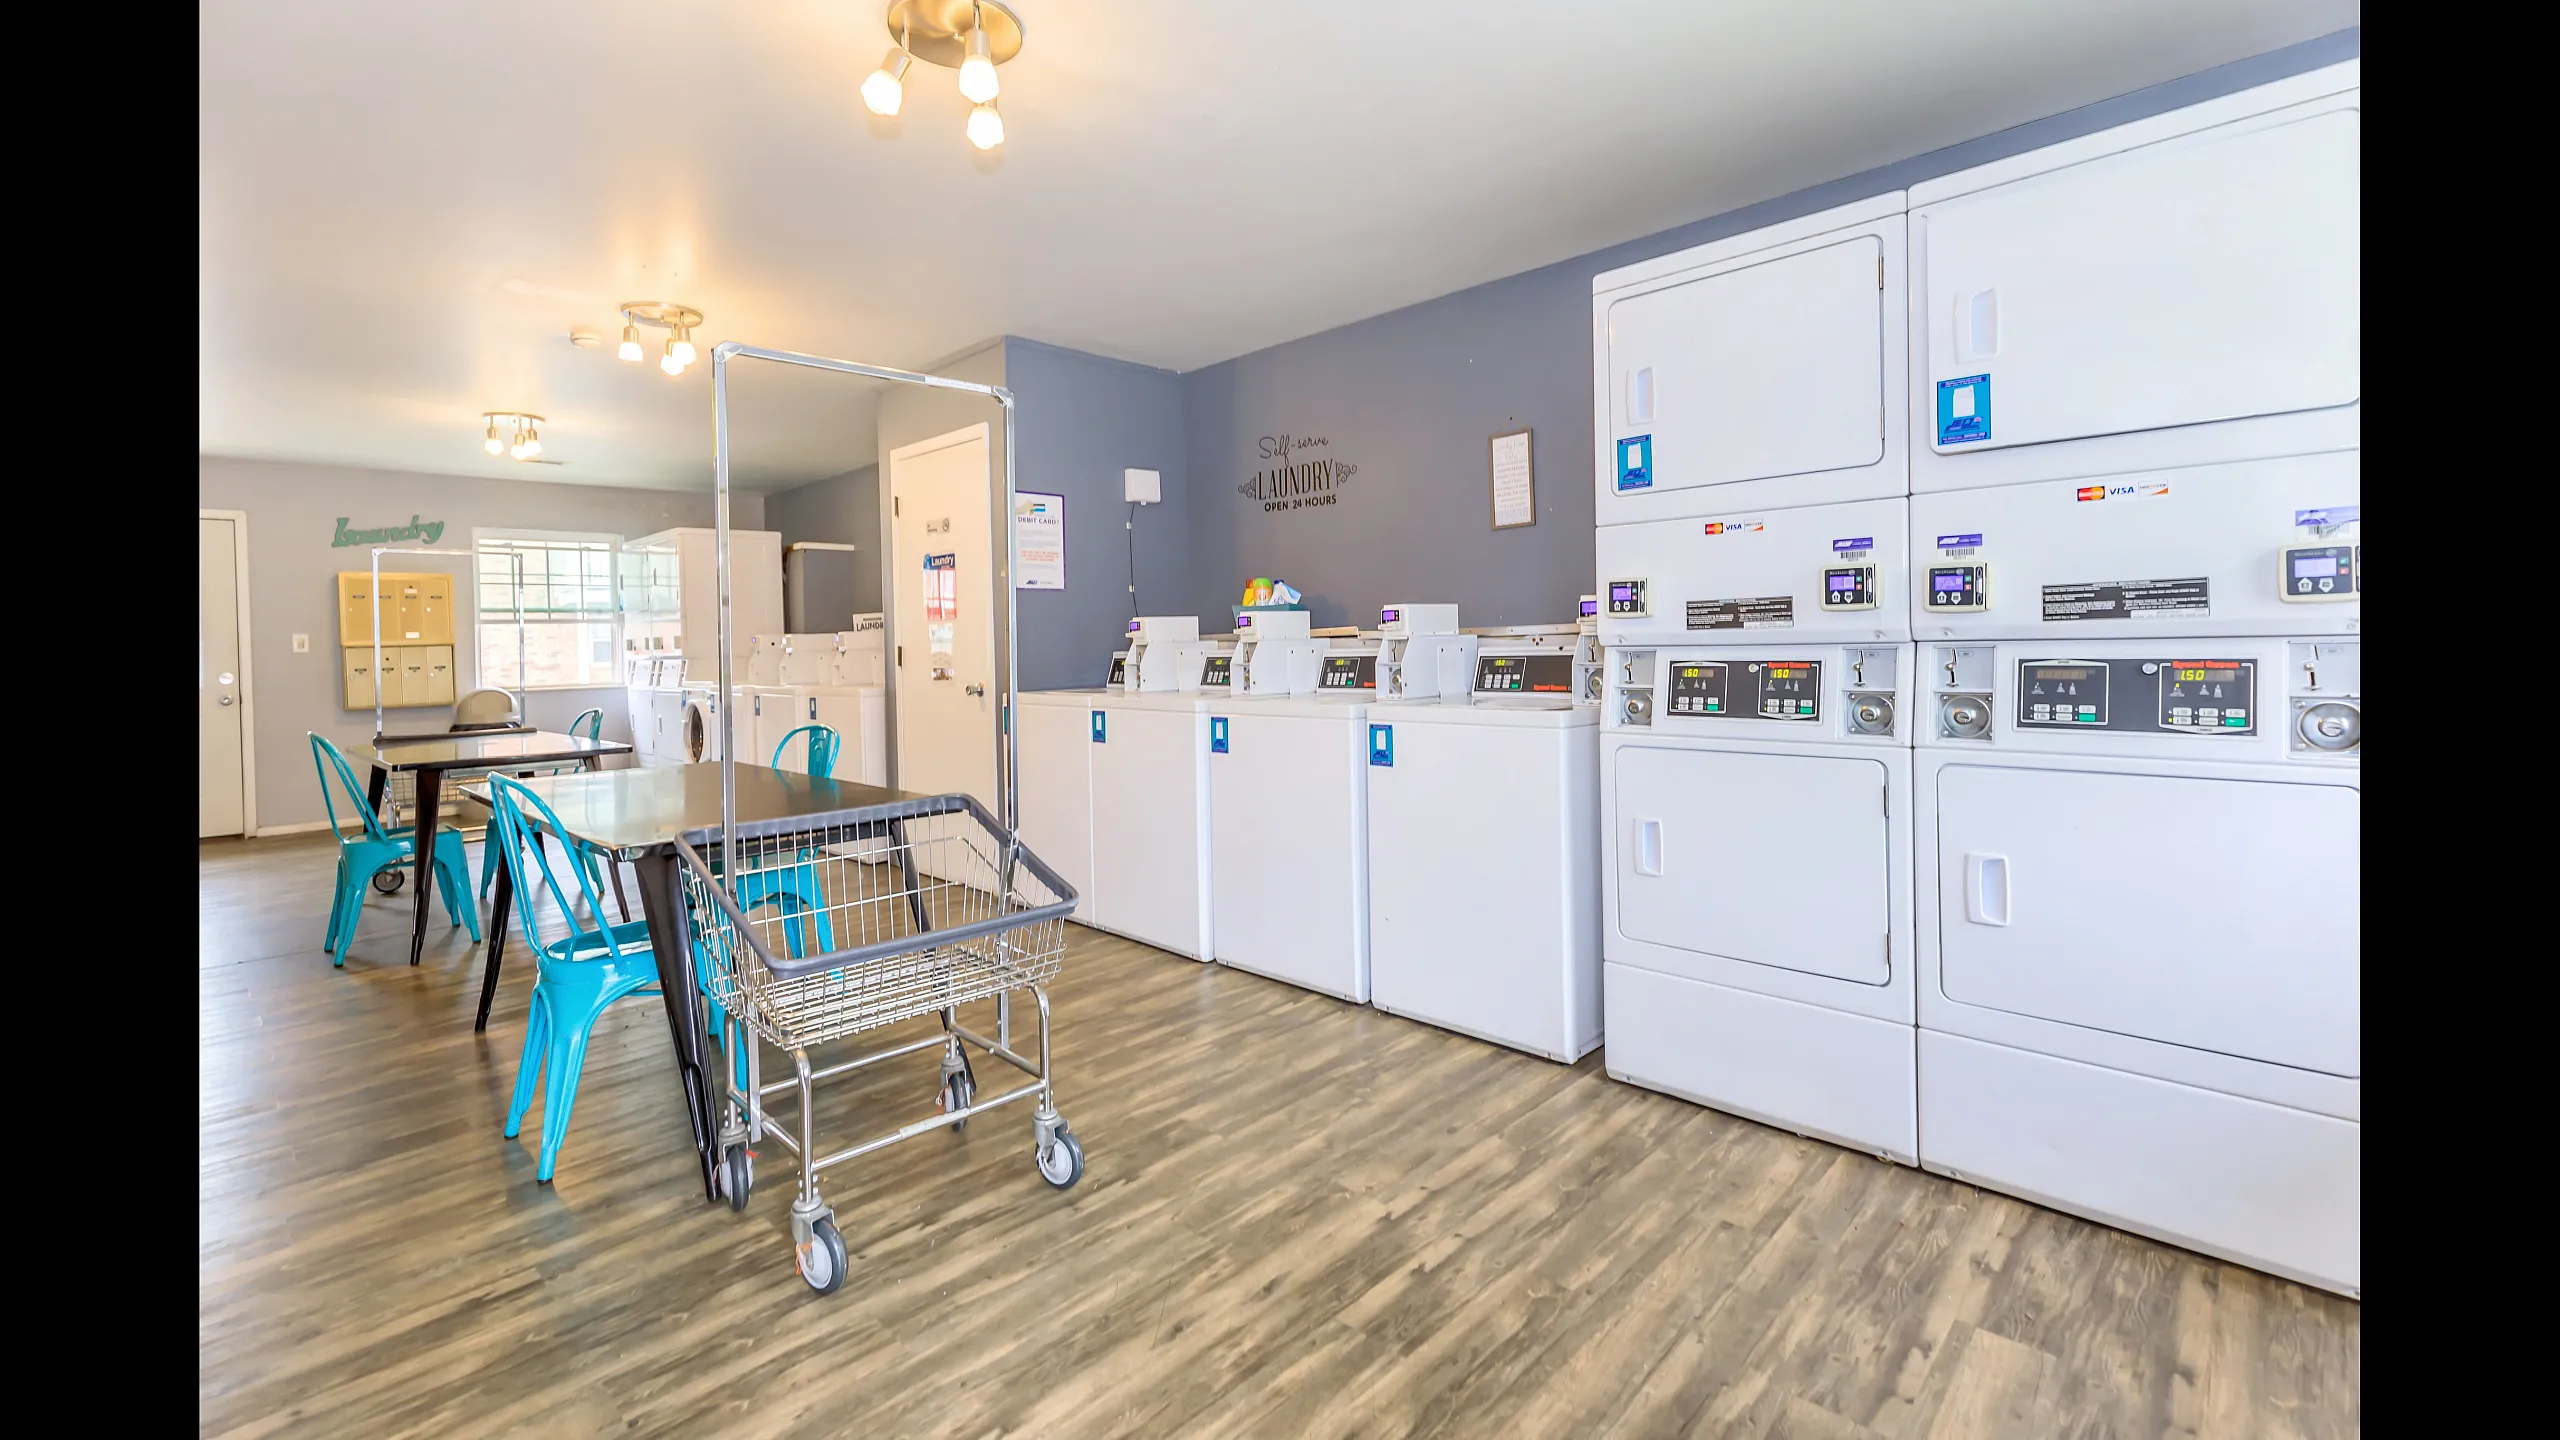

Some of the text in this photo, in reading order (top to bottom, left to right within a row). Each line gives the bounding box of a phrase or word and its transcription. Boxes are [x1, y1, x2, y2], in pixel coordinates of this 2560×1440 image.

[1259, 434, 1329, 468] Self-serve
[1258, 458, 1334, 500] LAUNDRY
[2109, 486, 2135, 495] VISA
[1264, 495, 1337, 512] OPEN 24 HOURS
[1017, 516, 1060, 527] DEBIT CARD?
[1725, 523, 1742, 531] VISA
[331, 514, 445, 547] Laundry
[931, 555, 954, 567] Laundry
[856, 621, 884, 632] LAUNDR
